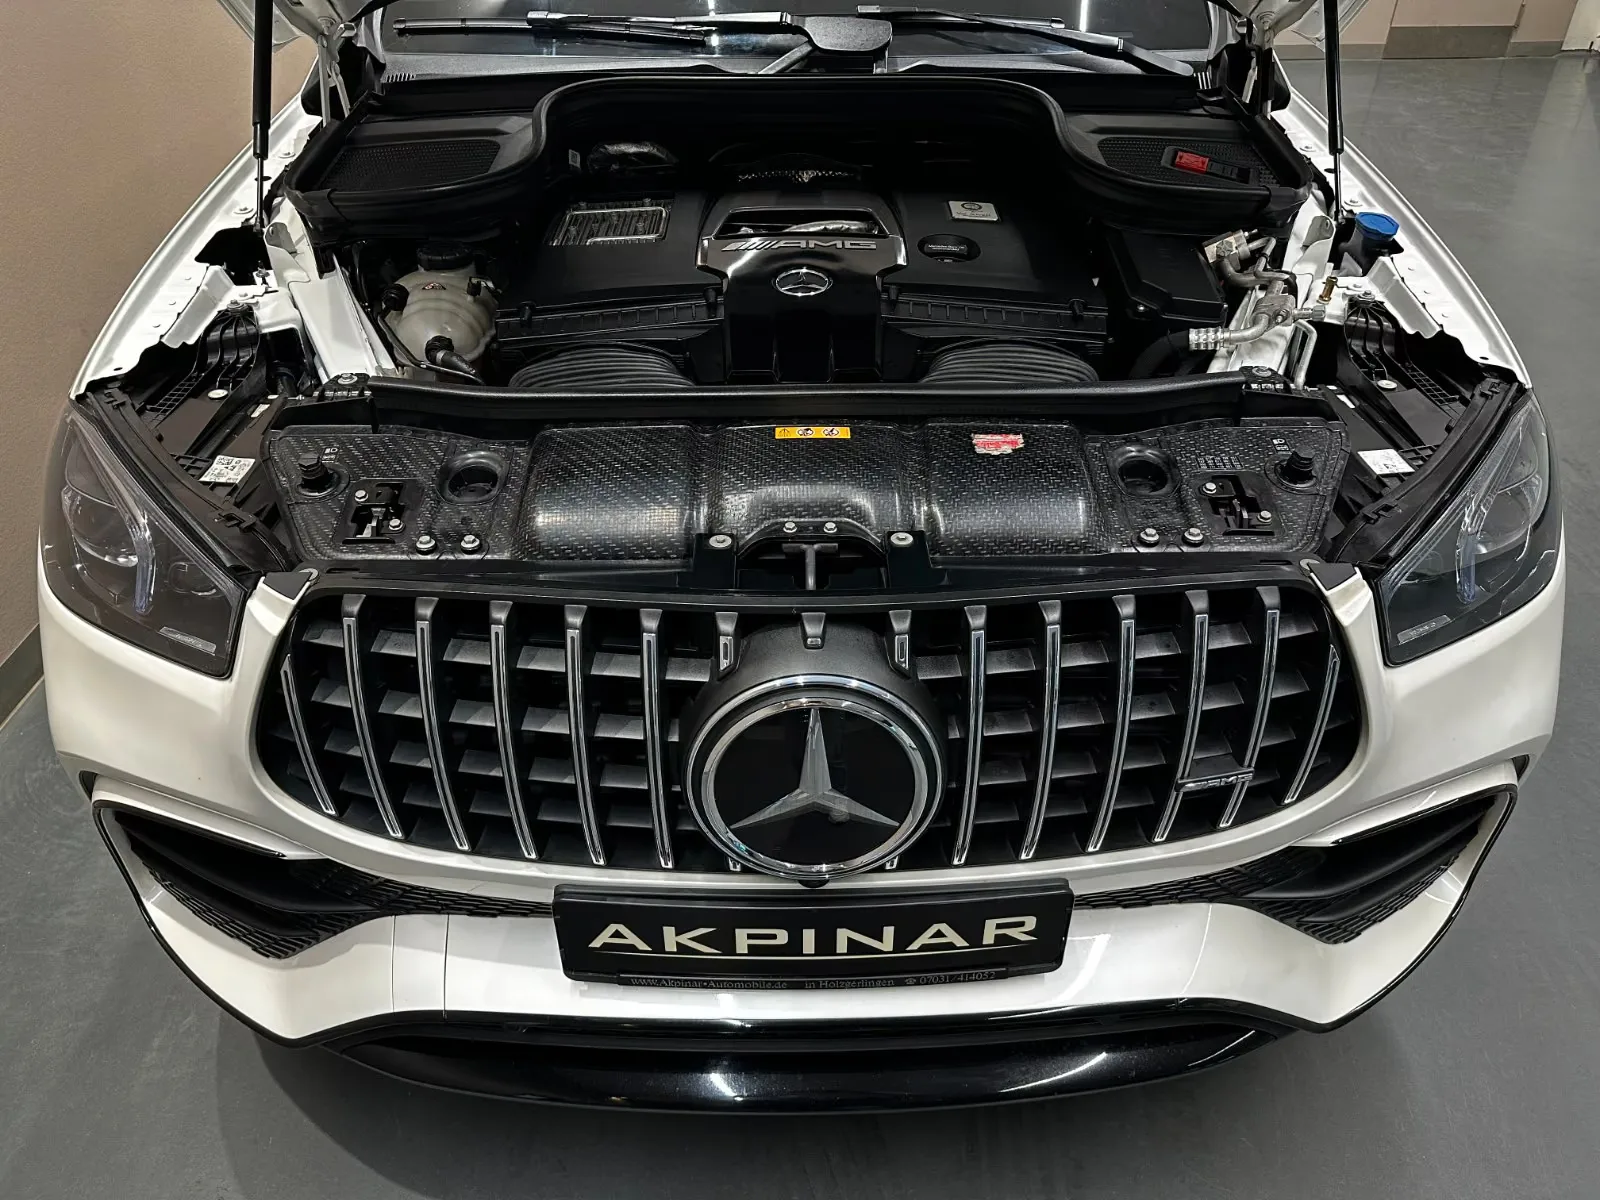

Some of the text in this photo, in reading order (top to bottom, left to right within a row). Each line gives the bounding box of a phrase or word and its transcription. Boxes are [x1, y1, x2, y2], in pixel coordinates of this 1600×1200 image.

[771, 239, 877, 251] AMG
[588, 915, 1038, 955] AKPINAR
[804, 979, 816, 989] in
[819, 978, 895, 990] Holzgerlingen
